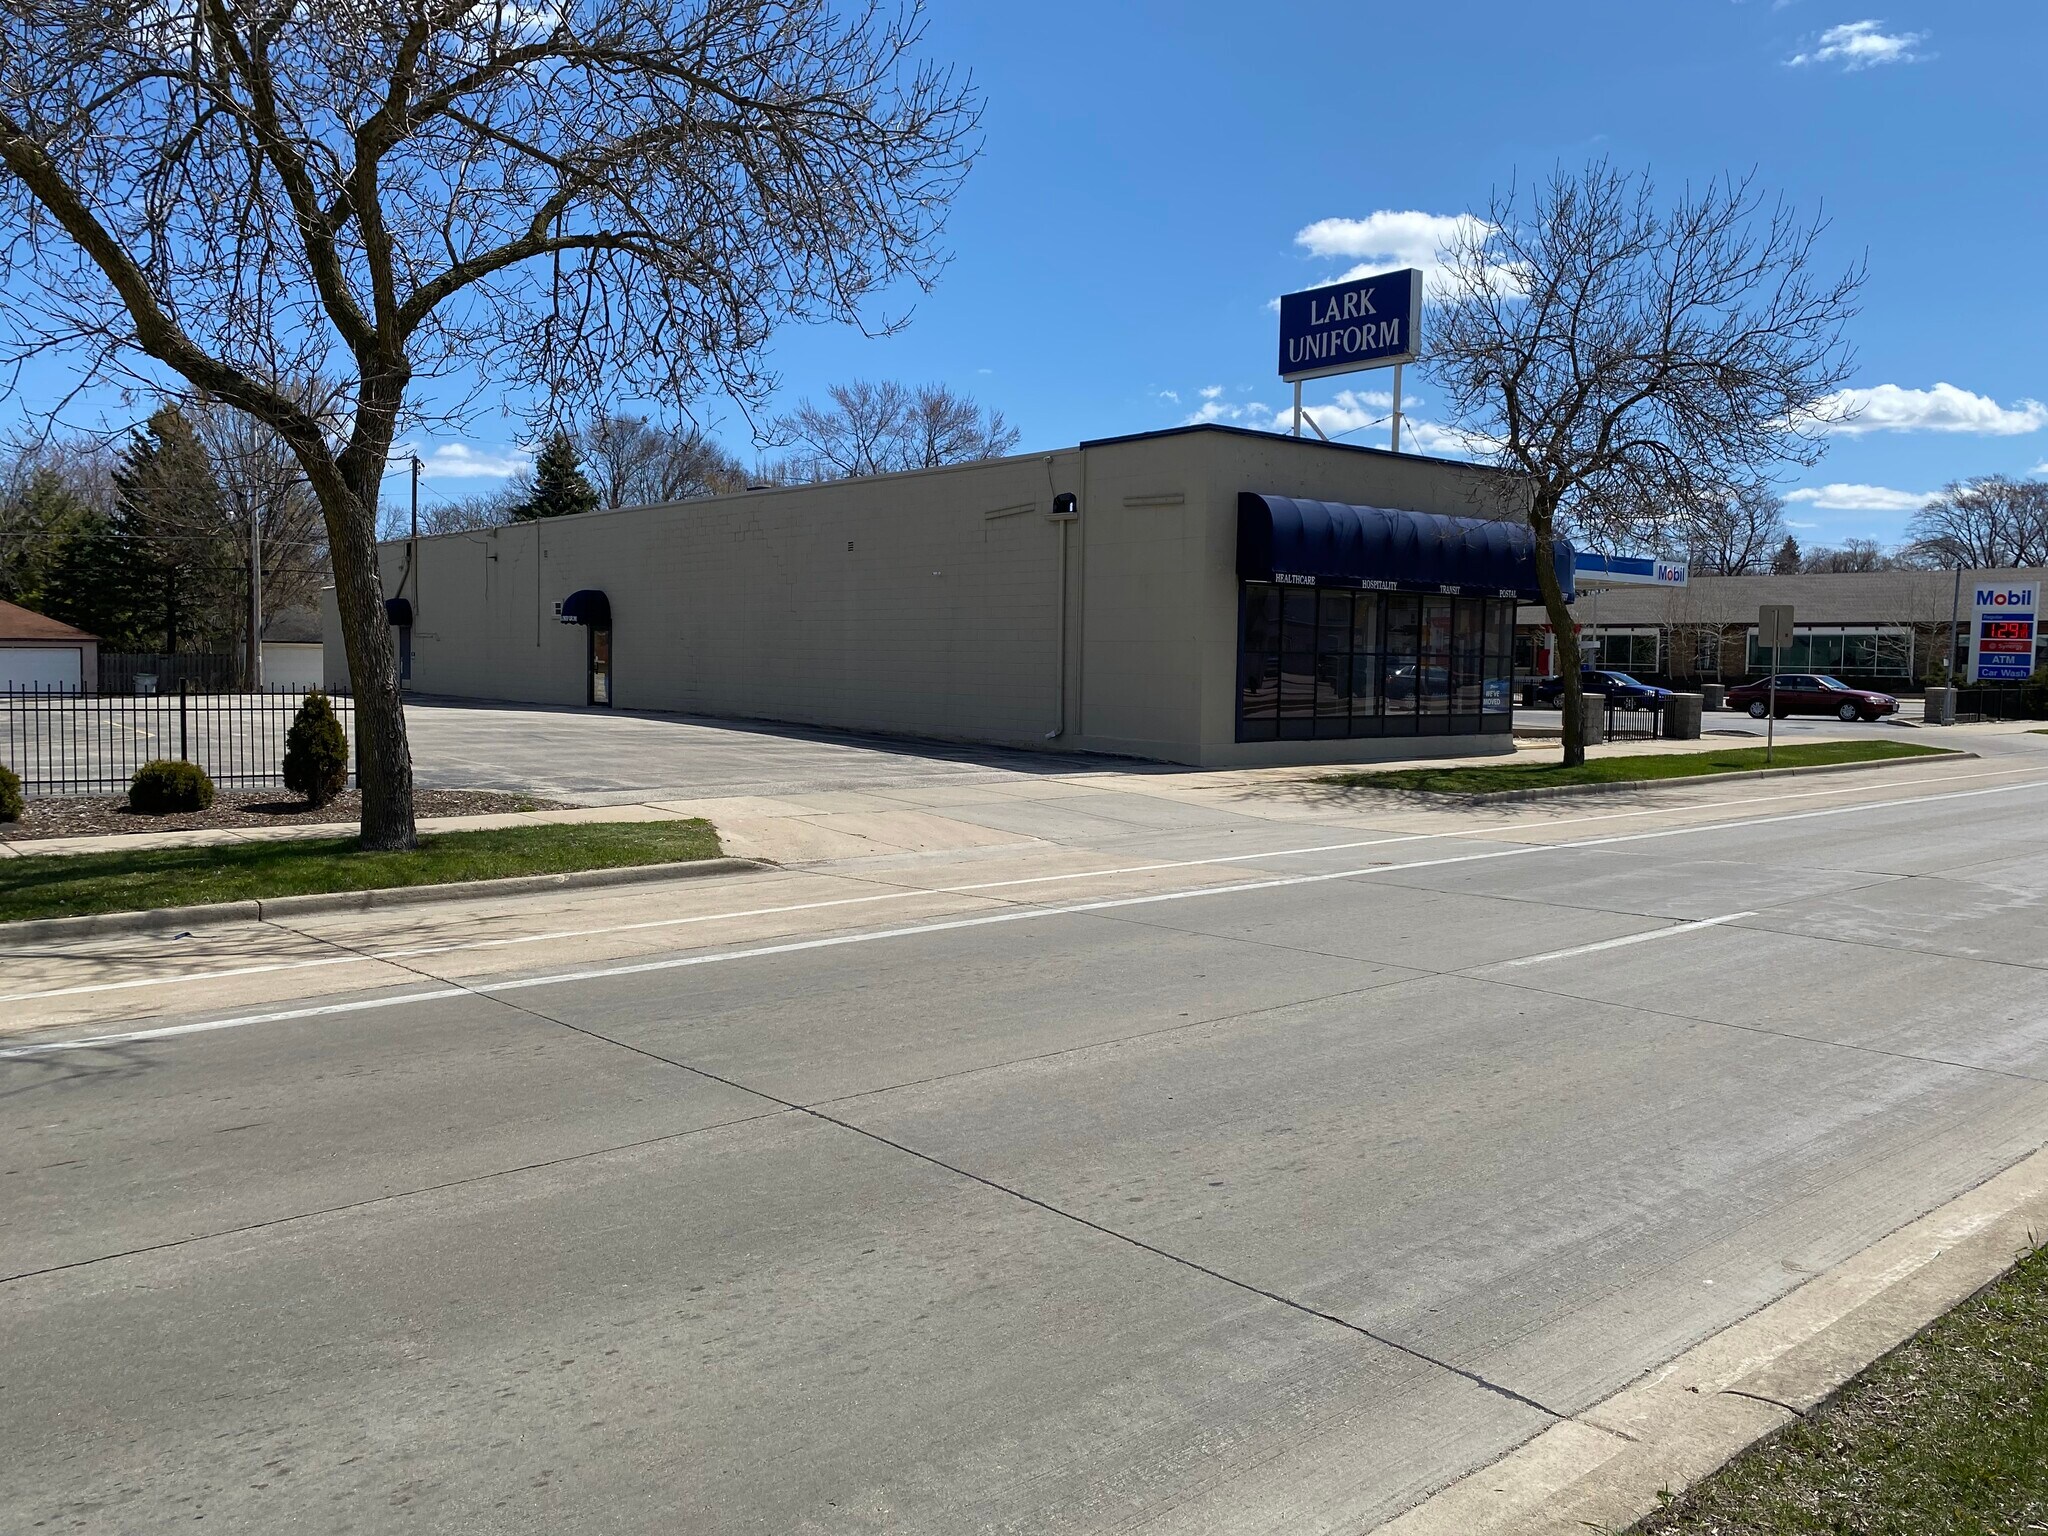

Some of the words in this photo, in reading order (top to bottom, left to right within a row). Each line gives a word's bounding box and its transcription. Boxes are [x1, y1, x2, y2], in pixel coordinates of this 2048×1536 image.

[1311, 288, 1377, 326] LARK
[1289, 318, 1400, 363] UNIFORM
[1275, 573, 1316, 586] HEALTHCARE
[1658, 565, 1685, 582] Mobil
[1362, 579, 1398, 591] HOSPITALITY
[1440, 585, 1461, 595] TRANSIT
[1499, 589, 1517, 598] POSTAL
[1976, 590, 2031, 606] Mobil
[1992, 655, 2015, 664] ATM
[1981, 668, 1998, 677] Car
[2001, 669, 2027, 678] Wash
[1483, 698, 1501, 706] MOVED
